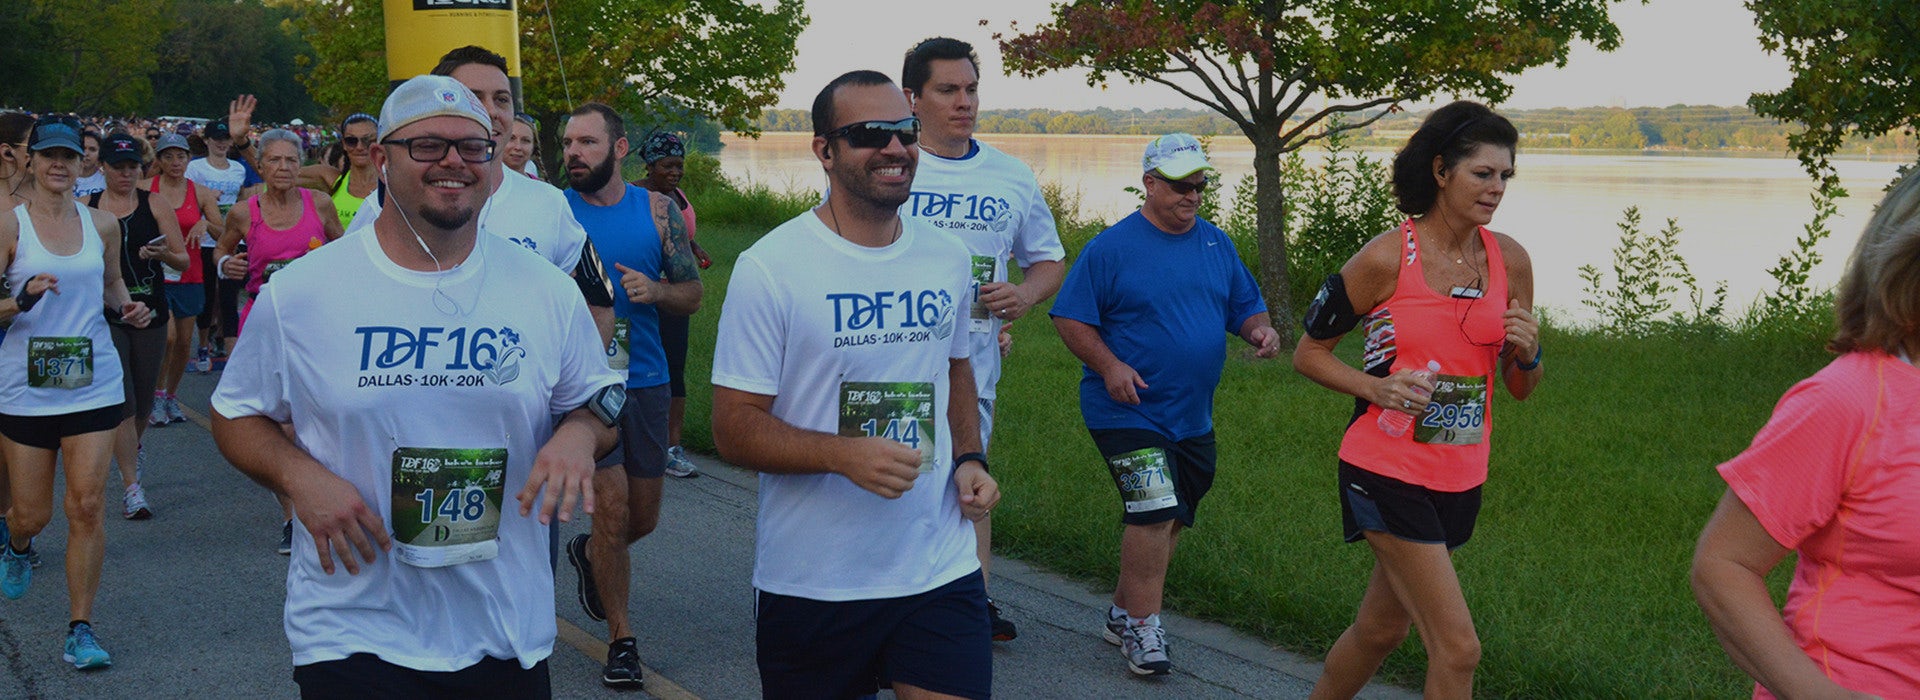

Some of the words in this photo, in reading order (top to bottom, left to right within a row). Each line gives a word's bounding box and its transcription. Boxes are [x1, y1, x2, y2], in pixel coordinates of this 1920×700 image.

[34, 357, 86, 377] 1371
[1422, 401, 1483, 429] 2958
[861, 418, 921, 450] 144
[1120, 468, 1164, 491] 3271
[415, 488, 486, 523] 148
